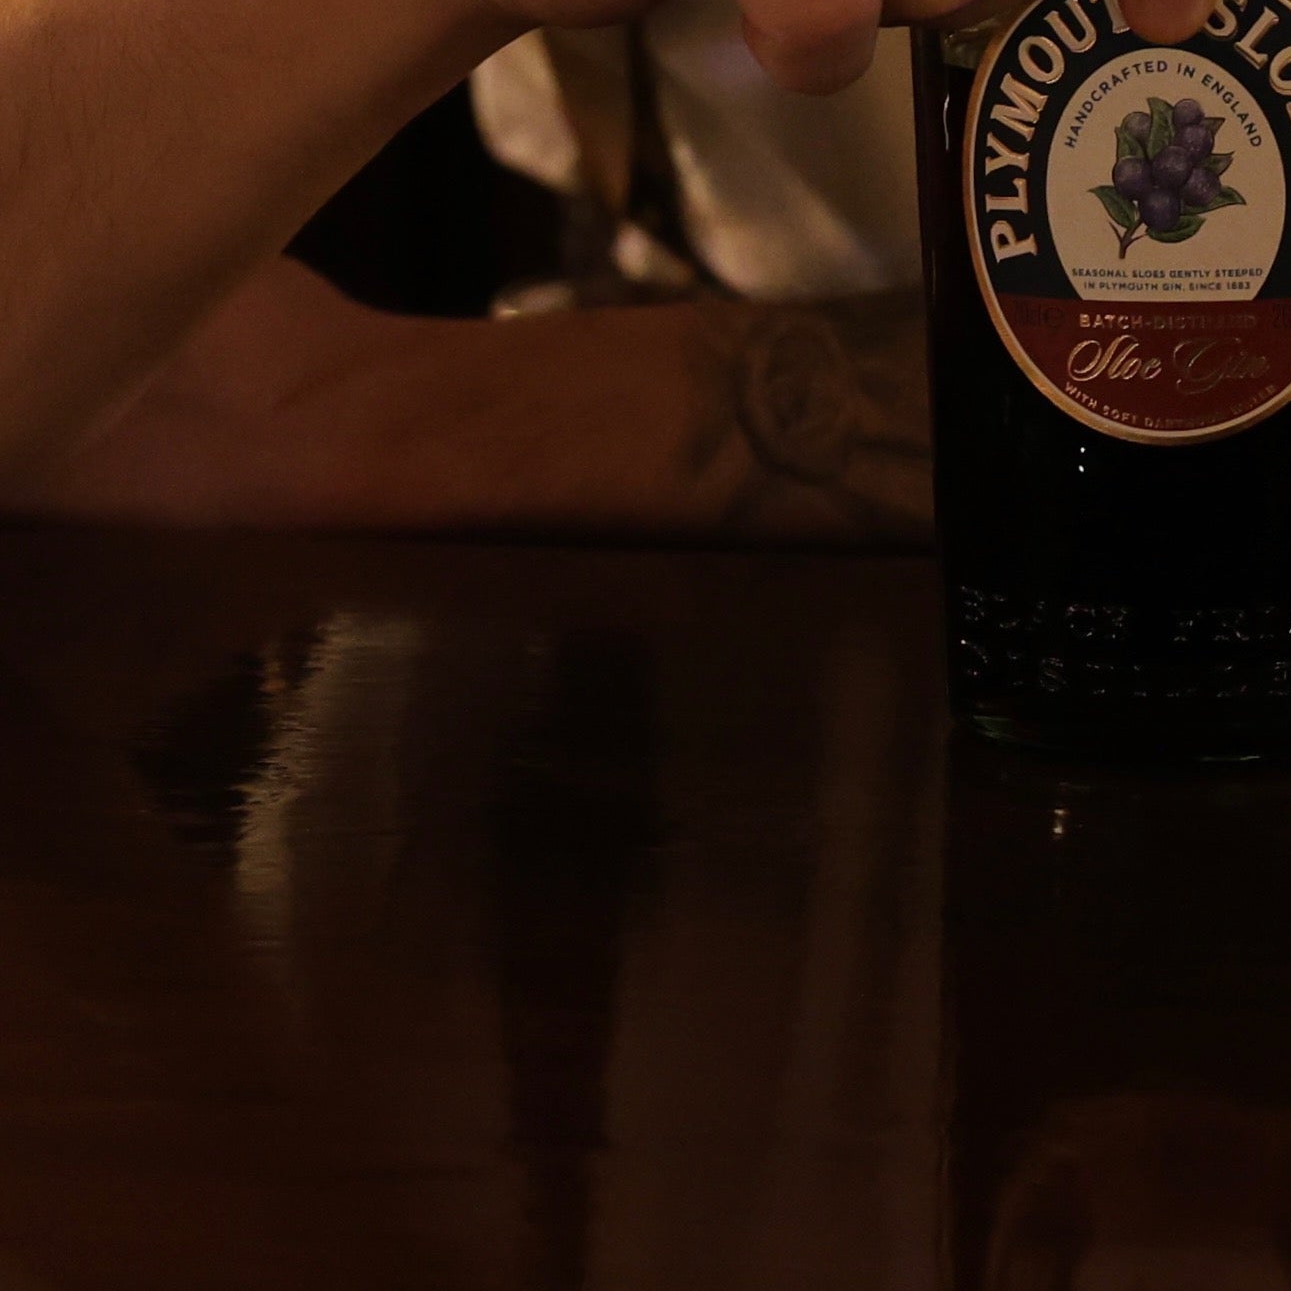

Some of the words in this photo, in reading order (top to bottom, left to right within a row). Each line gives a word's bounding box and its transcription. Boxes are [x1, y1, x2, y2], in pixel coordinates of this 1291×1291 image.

[1065, 60, 1168, 149] HANDCRAFTED
[1176, 63, 1196, 78] IN
[1201, 74, 1262, 148] ENGLAND
[1065, 334, 1163, 382] Sloe
